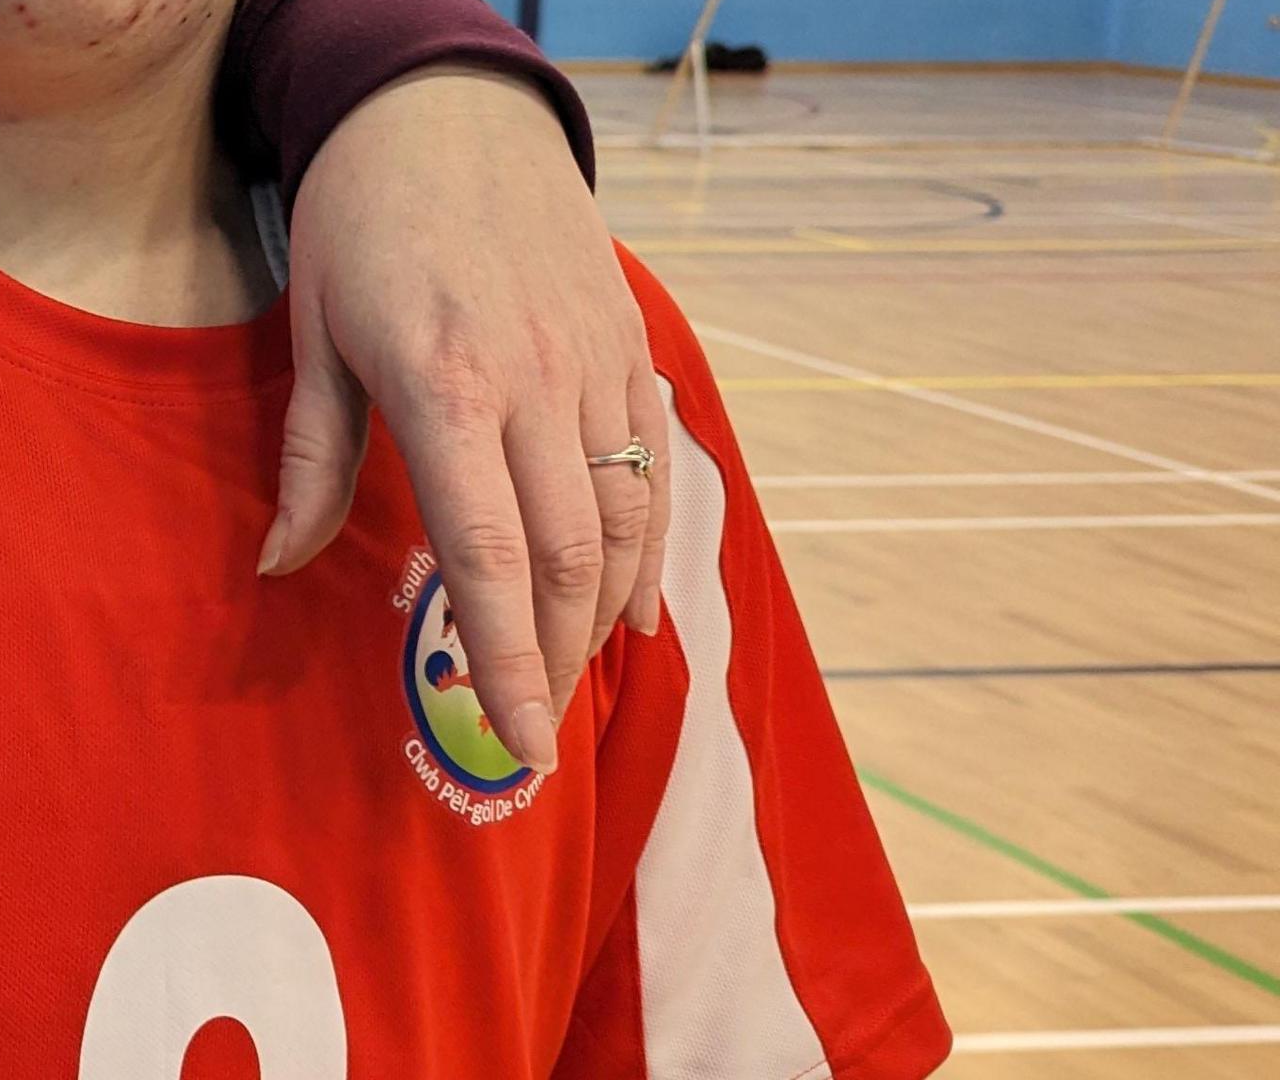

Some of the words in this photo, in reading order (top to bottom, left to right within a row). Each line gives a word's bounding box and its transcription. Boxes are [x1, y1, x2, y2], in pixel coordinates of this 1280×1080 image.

[393, 551, 436, 613] South
[404, 738, 439, 793] Clwb
[438, 781, 495, 826] Pêl-gôl
[495, 799, 513, 821] De
